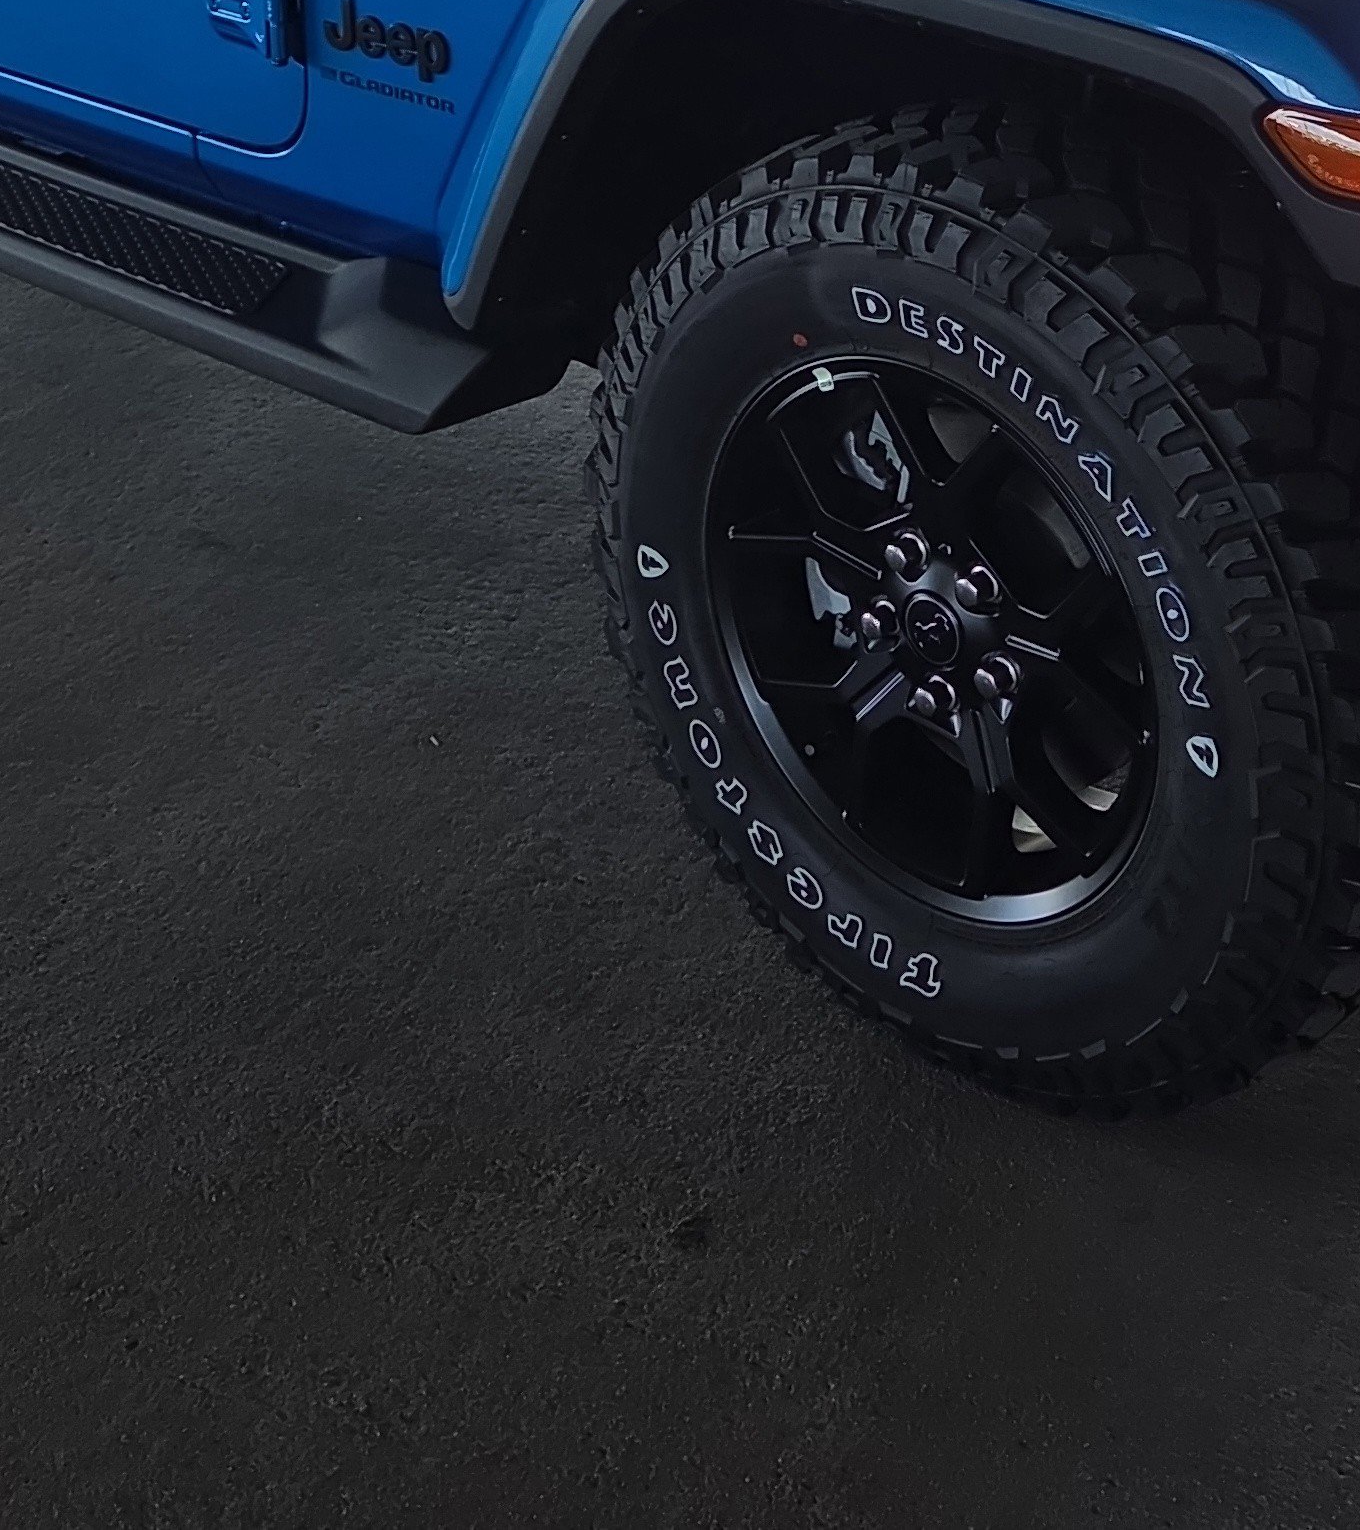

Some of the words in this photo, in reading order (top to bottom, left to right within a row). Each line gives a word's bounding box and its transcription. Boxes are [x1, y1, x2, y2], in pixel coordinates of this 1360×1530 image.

[340, 70, 456, 115] GLADIATOR
[852, 285, 1211, 711] DESTINATION
[648, 598, 943, 998] Firestone
